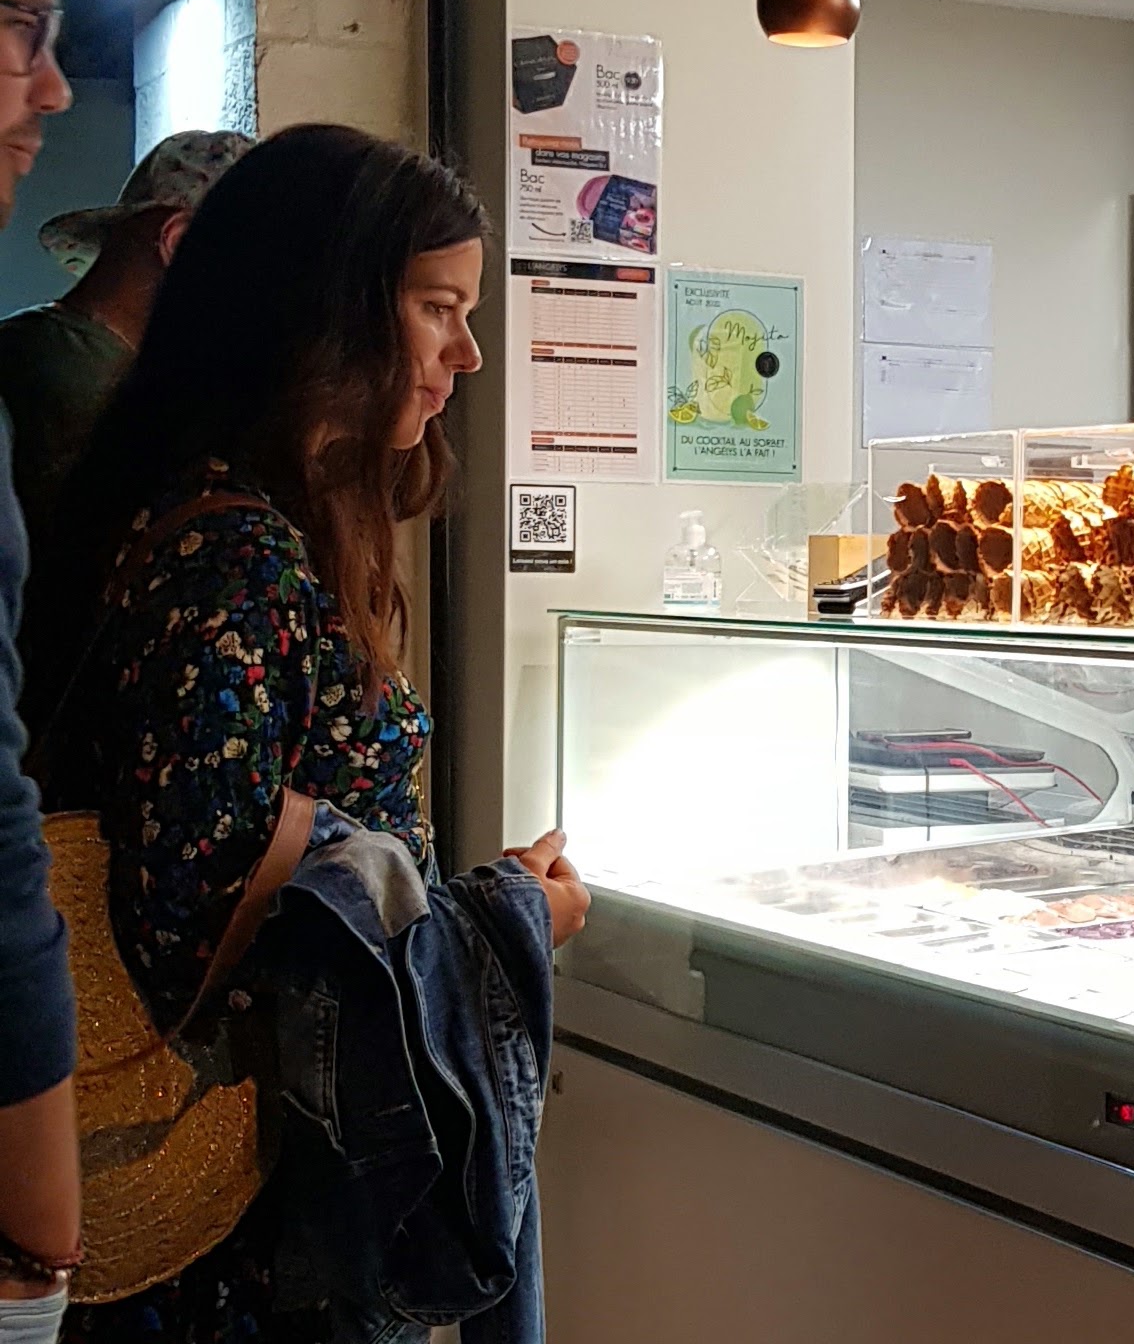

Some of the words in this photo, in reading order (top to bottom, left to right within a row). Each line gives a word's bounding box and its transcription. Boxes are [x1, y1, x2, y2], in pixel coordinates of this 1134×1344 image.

[596, 64, 621, 80] Bac
[520, 169, 545, 184] Bac
[724, 320, 790, 352] Mojito
[680, 435, 694, 445] DU
[696, 435, 736, 446] COCKTAIL
[739, 437, 751, 447] AU
[694, 446, 738, 457] L'ANGELYS
[754, 449, 770, 458] FAIT
